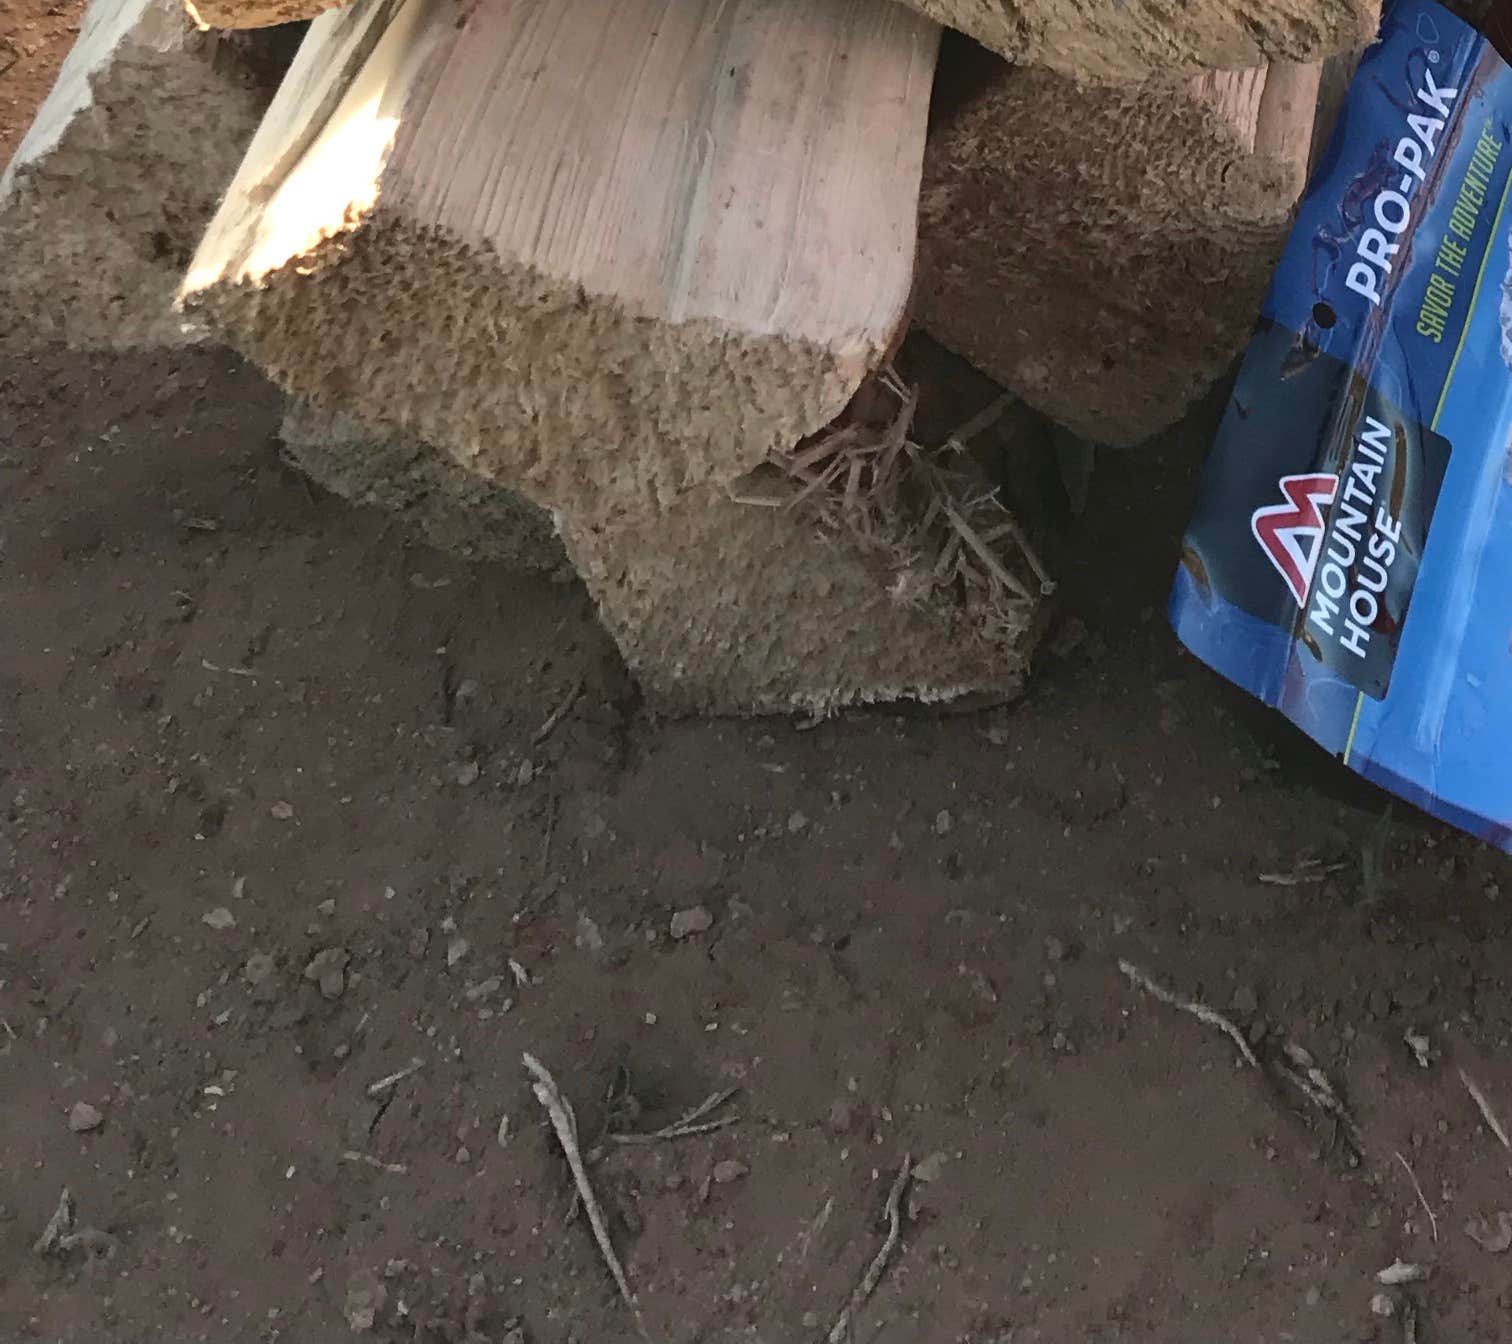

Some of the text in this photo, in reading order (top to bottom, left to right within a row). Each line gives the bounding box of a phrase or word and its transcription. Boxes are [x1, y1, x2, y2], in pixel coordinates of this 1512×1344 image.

[1345, 69, 1458, 306] PRO-PAK
[1416, 130, 1503, 344] SAVOR THE ADVENTURE
[1310, 415, 1392, 636] MOUNTAIN
[1340, 506, 1401, 659] HOUSE
